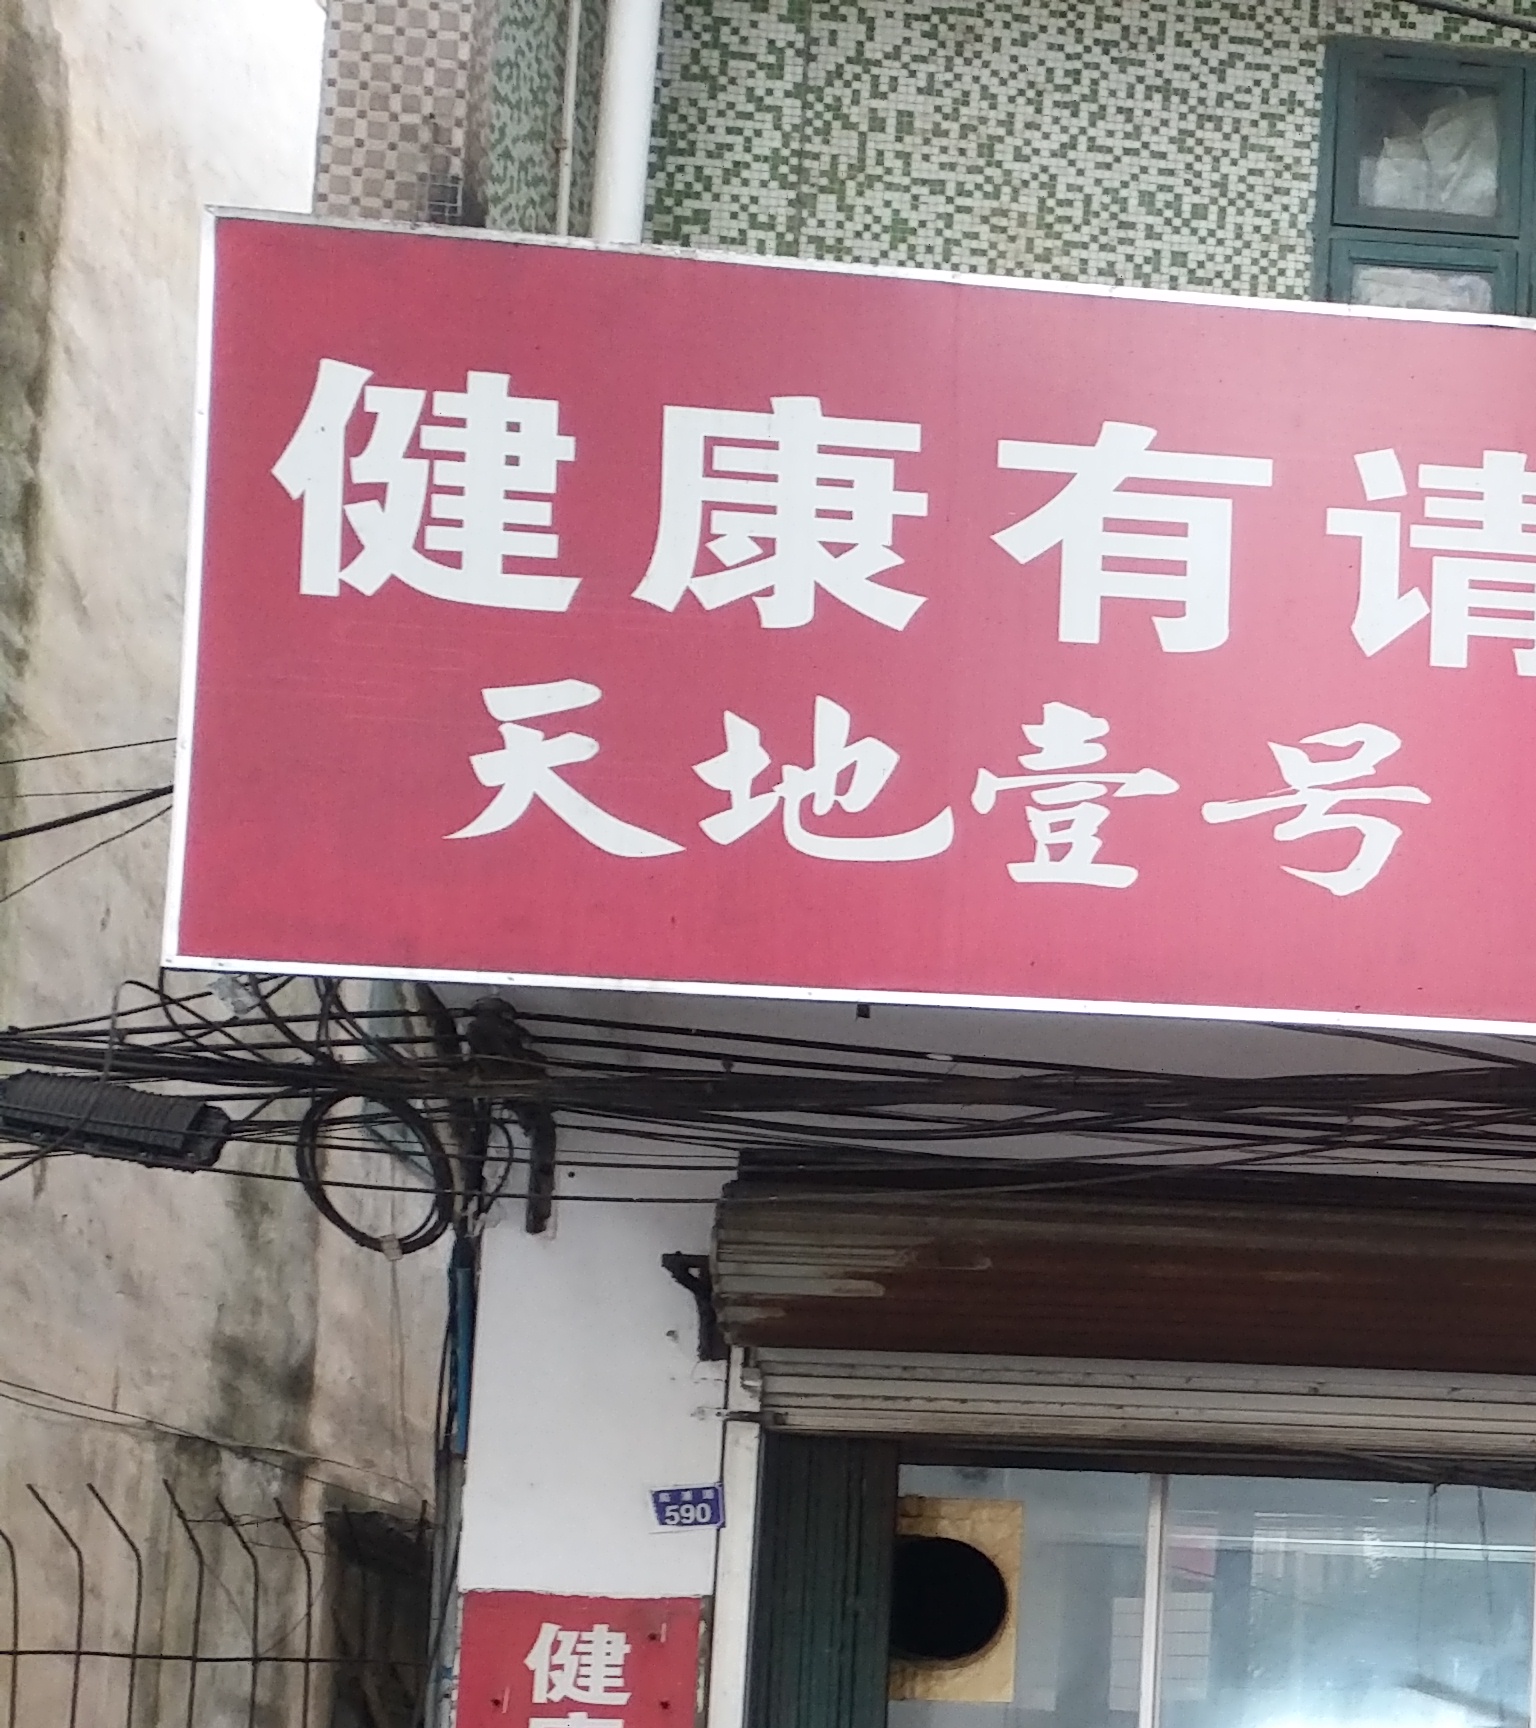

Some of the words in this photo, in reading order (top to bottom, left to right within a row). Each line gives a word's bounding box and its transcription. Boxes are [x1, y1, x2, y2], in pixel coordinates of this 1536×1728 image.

[446, 678, 1432, 896] 天地壹号
[665, 1502, 712, 1525] 590
